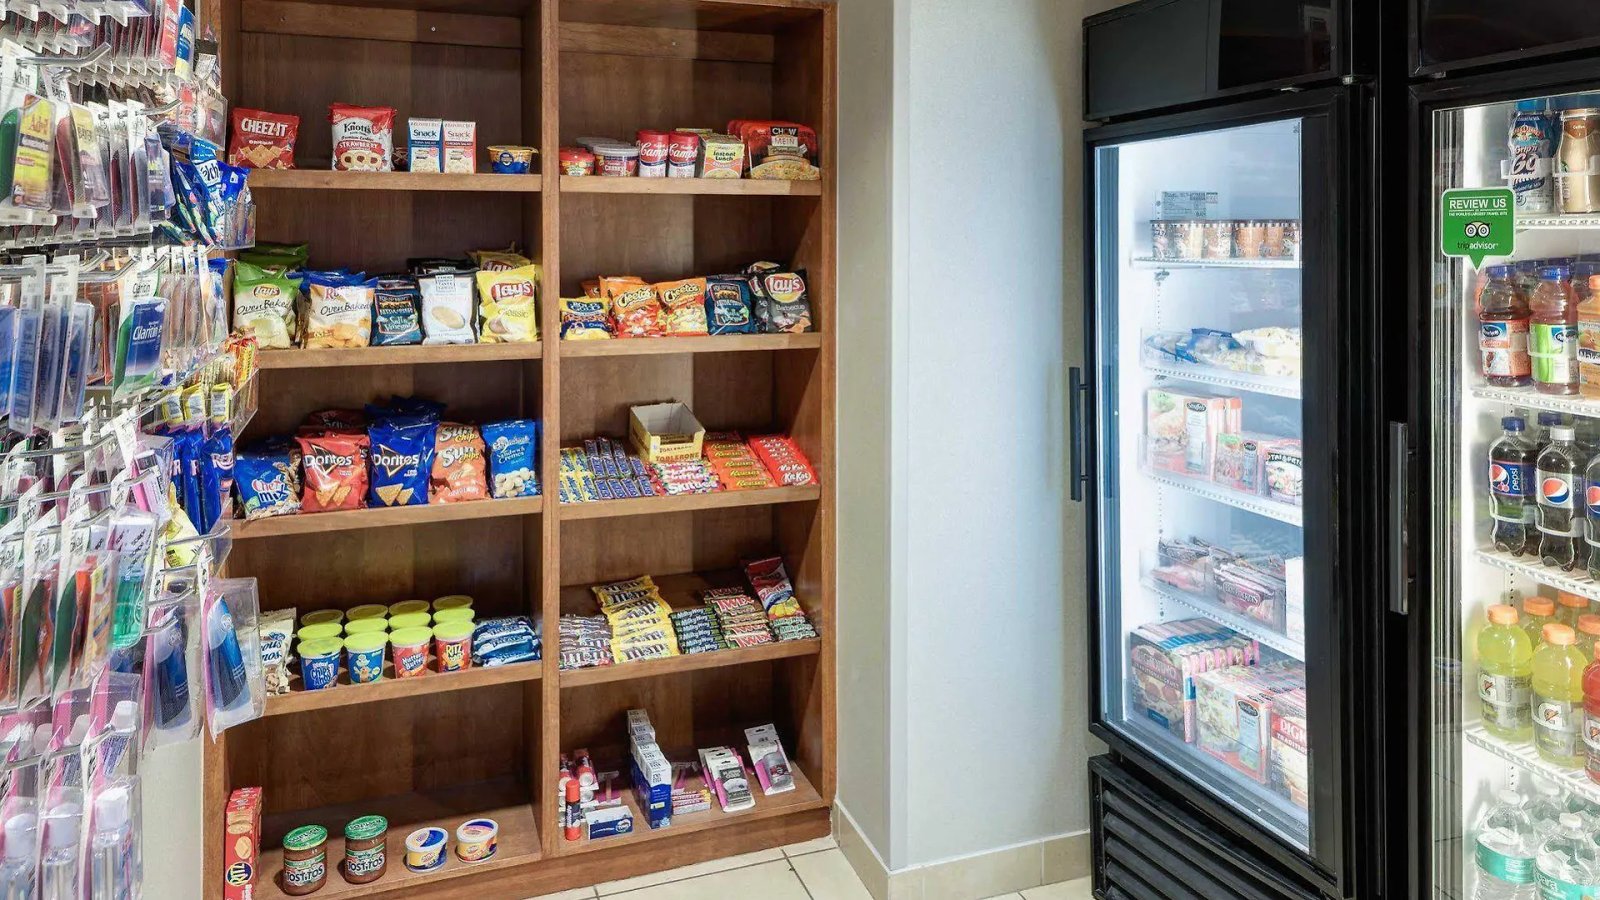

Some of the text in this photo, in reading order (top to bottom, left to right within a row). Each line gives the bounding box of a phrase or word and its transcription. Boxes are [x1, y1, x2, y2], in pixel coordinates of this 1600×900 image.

[413, 129, 437, 138] Snack
[772, 127, 797, 136] CHOW
[774, 137, 795, 145] MEIN
[1449, 199, 1488, 210] REVIEW
[1492, 198, 1507, 208] US
[1457, 241, 1497, 251] tripadvisor
[770, 276, 801, 294] Lay's
[236, 304, 266, 316] Oven
[320, 305, 344, 316] Oven
[439, 426, 474, 442] Sun
[304, 454, 353, 467] Doritos
[373, 453, 420, 467] Doritos
[442, 445, 476, 468] Sun
[251, 475, 284, 492] Chex
[1511, 467, 1520, 491] pepsi
[446, 645, 463, 658] RITZ
